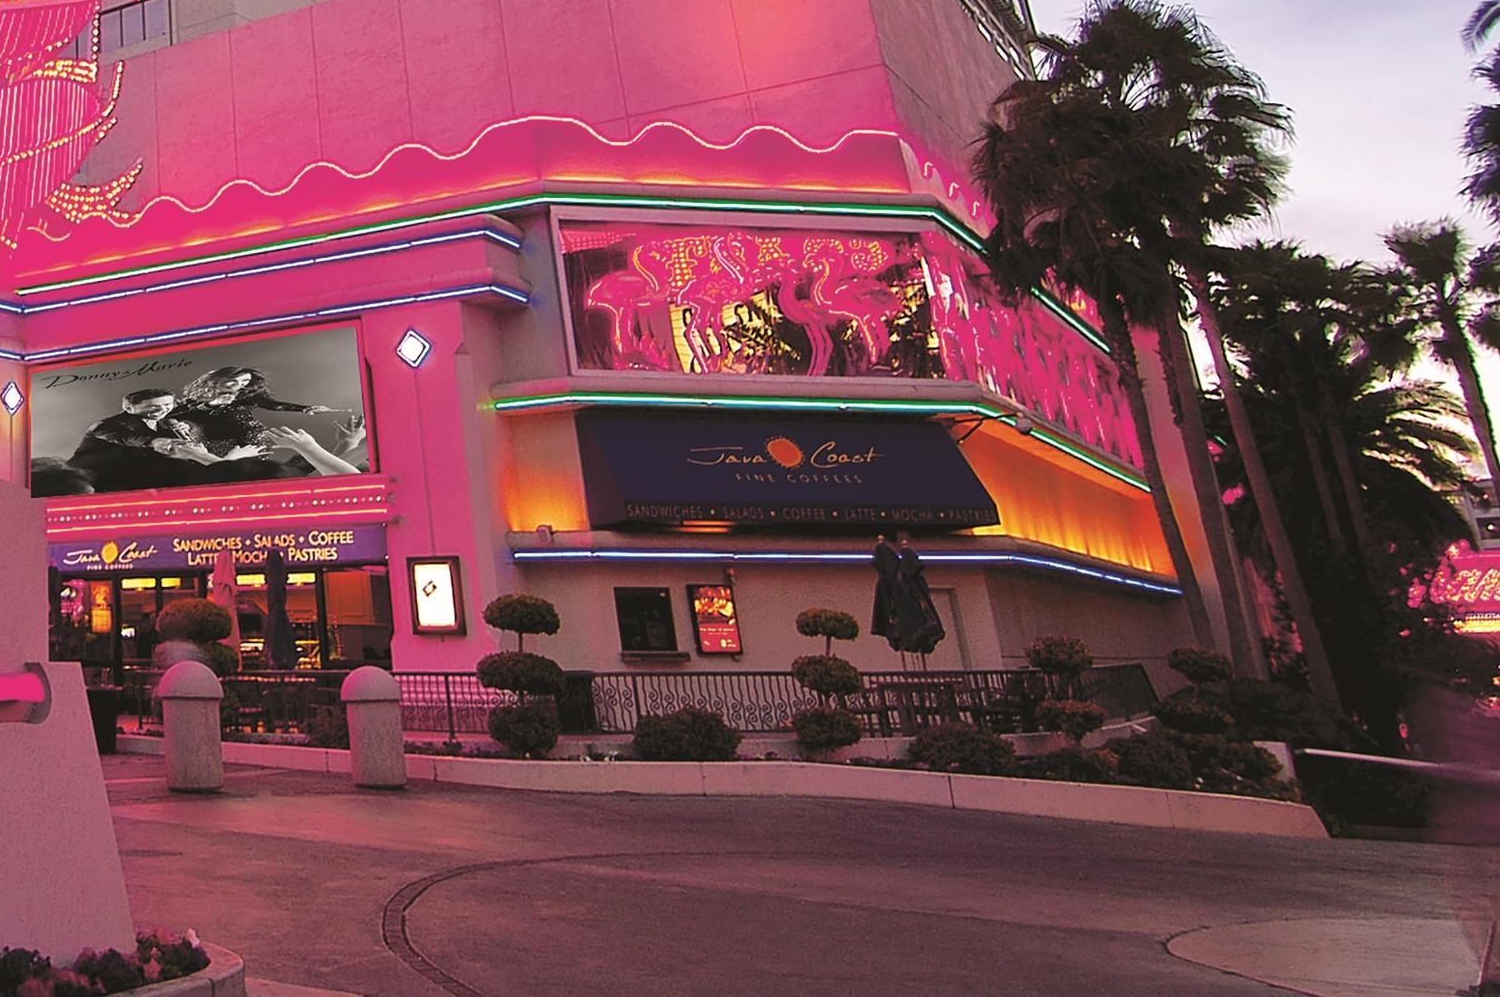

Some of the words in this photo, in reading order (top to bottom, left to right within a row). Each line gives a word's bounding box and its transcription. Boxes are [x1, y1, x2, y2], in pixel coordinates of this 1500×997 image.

[686, 446, 768, 467] Java
[810, 441, 885, 469] Coast
[173, 535, 242, 552] SANDWICHES
[308, 530, 354, 546] COFFEE
[232, 550, 268, 565] MOCH
[288, 547, 338, 562] PASTRIES
